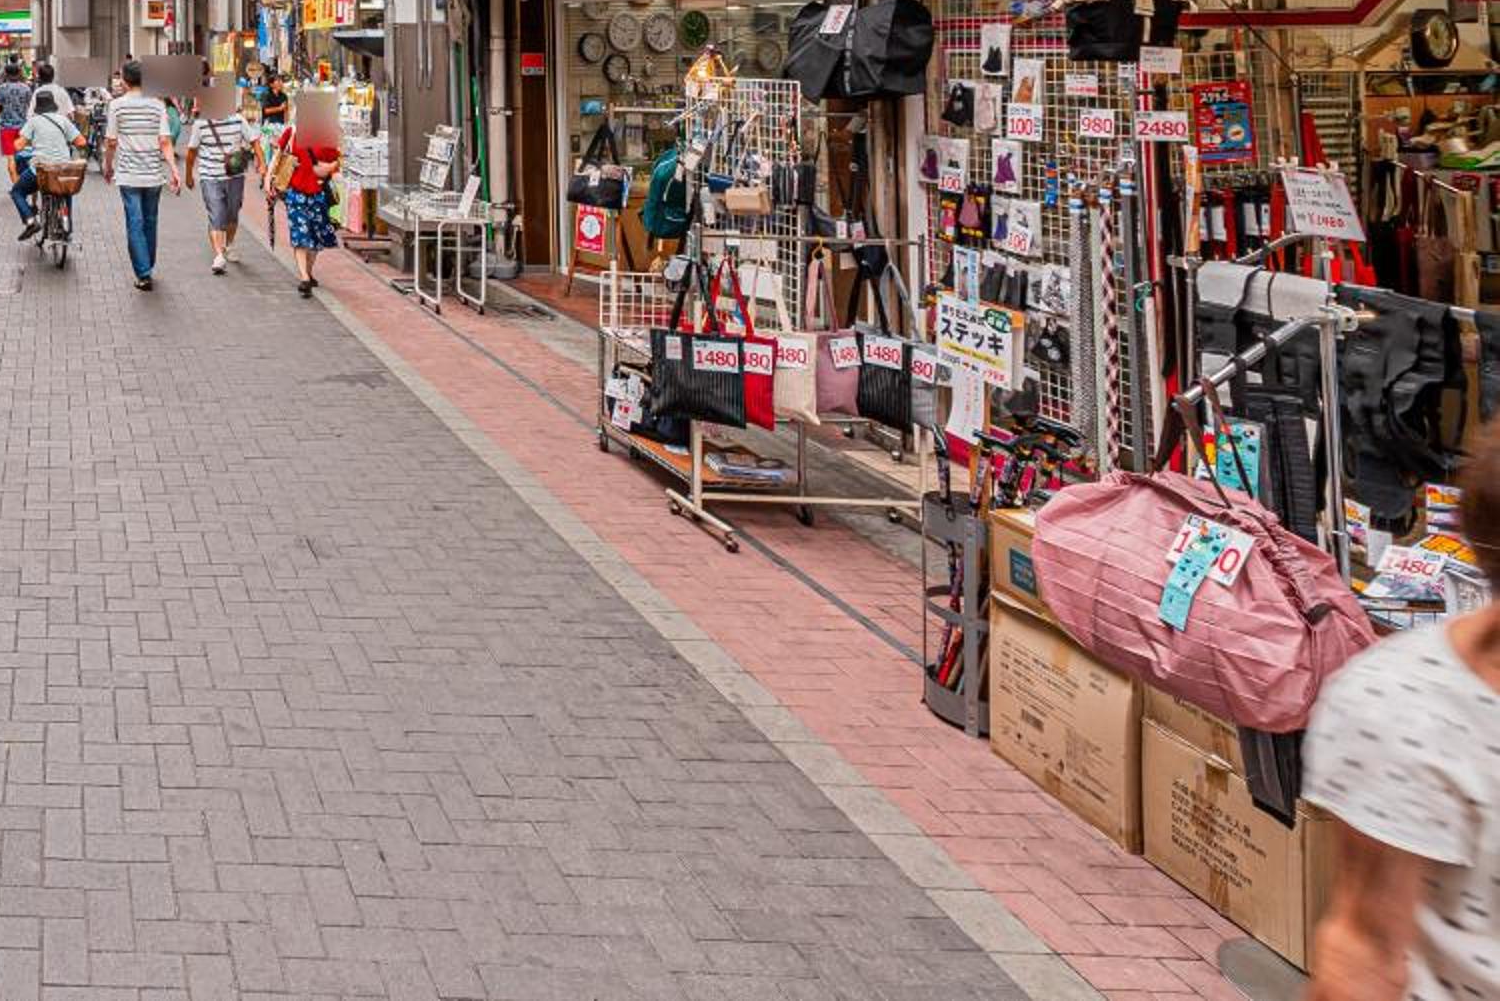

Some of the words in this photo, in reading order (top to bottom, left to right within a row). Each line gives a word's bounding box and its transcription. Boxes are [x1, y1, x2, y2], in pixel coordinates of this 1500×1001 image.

[1009, 118, 1033, 135] 100
[1081, 116, 1113, 134] 980
[1138, 120, 1187, 137] 2480
[941, 318, 1005, 356] ステッキ
[695, 350, 737, 367] 1480
[866, 344, 901, 365] 1480
[1172, 529, 1240, 574] 10
